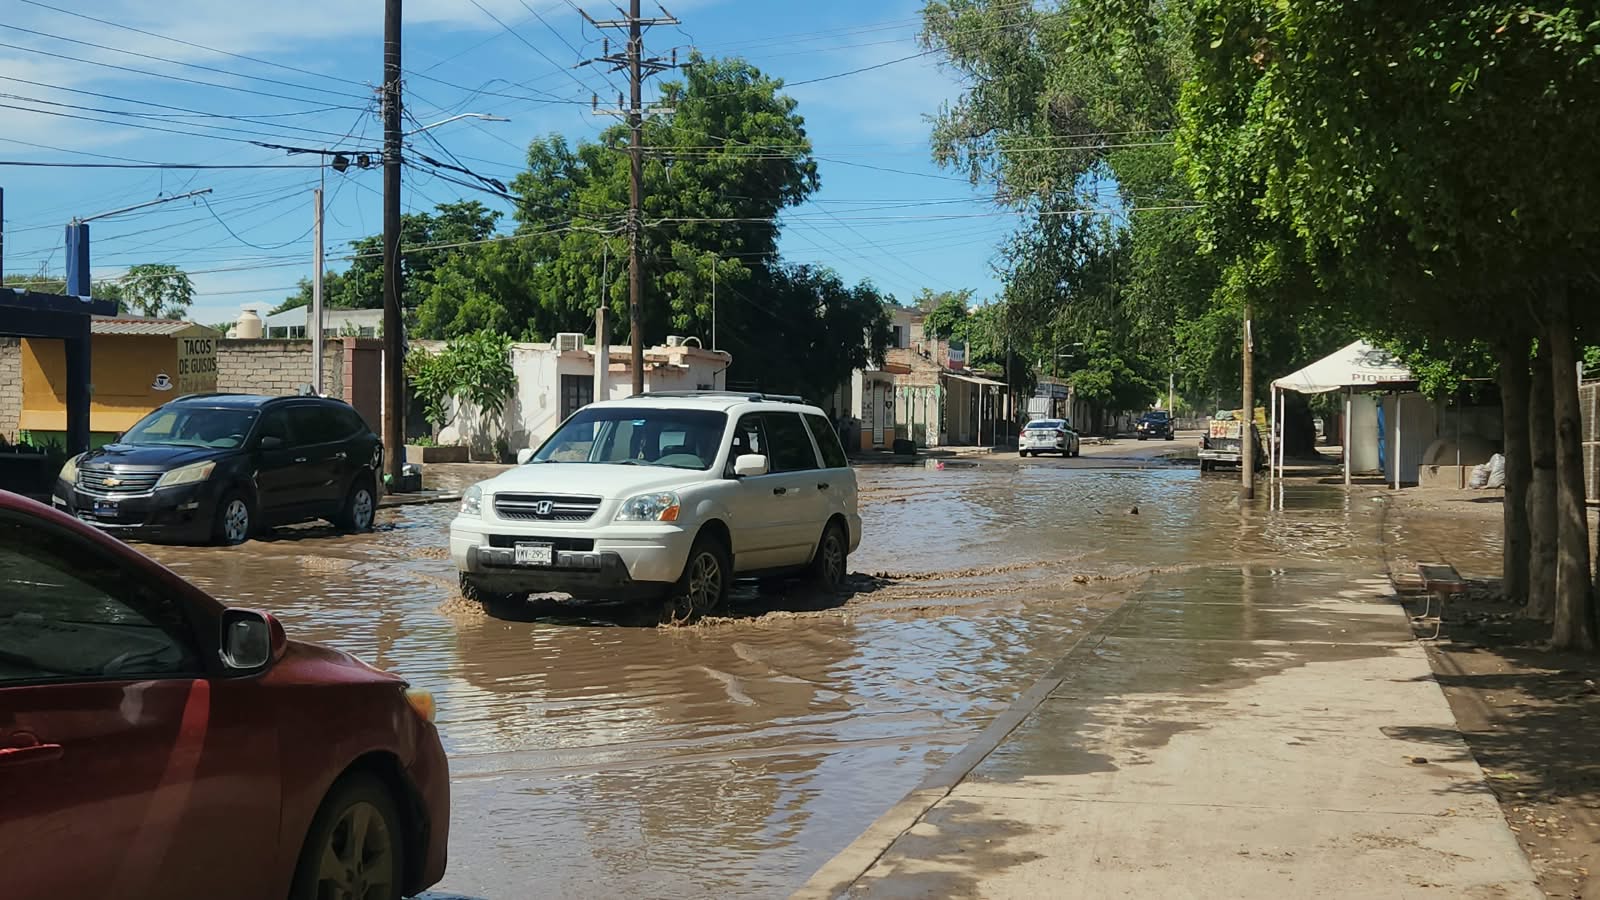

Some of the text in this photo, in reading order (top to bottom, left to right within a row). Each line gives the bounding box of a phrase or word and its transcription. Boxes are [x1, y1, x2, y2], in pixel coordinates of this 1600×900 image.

[184, 339, 211, 355] TACOS
[179, 357, 216, 374] DE GUISOS
